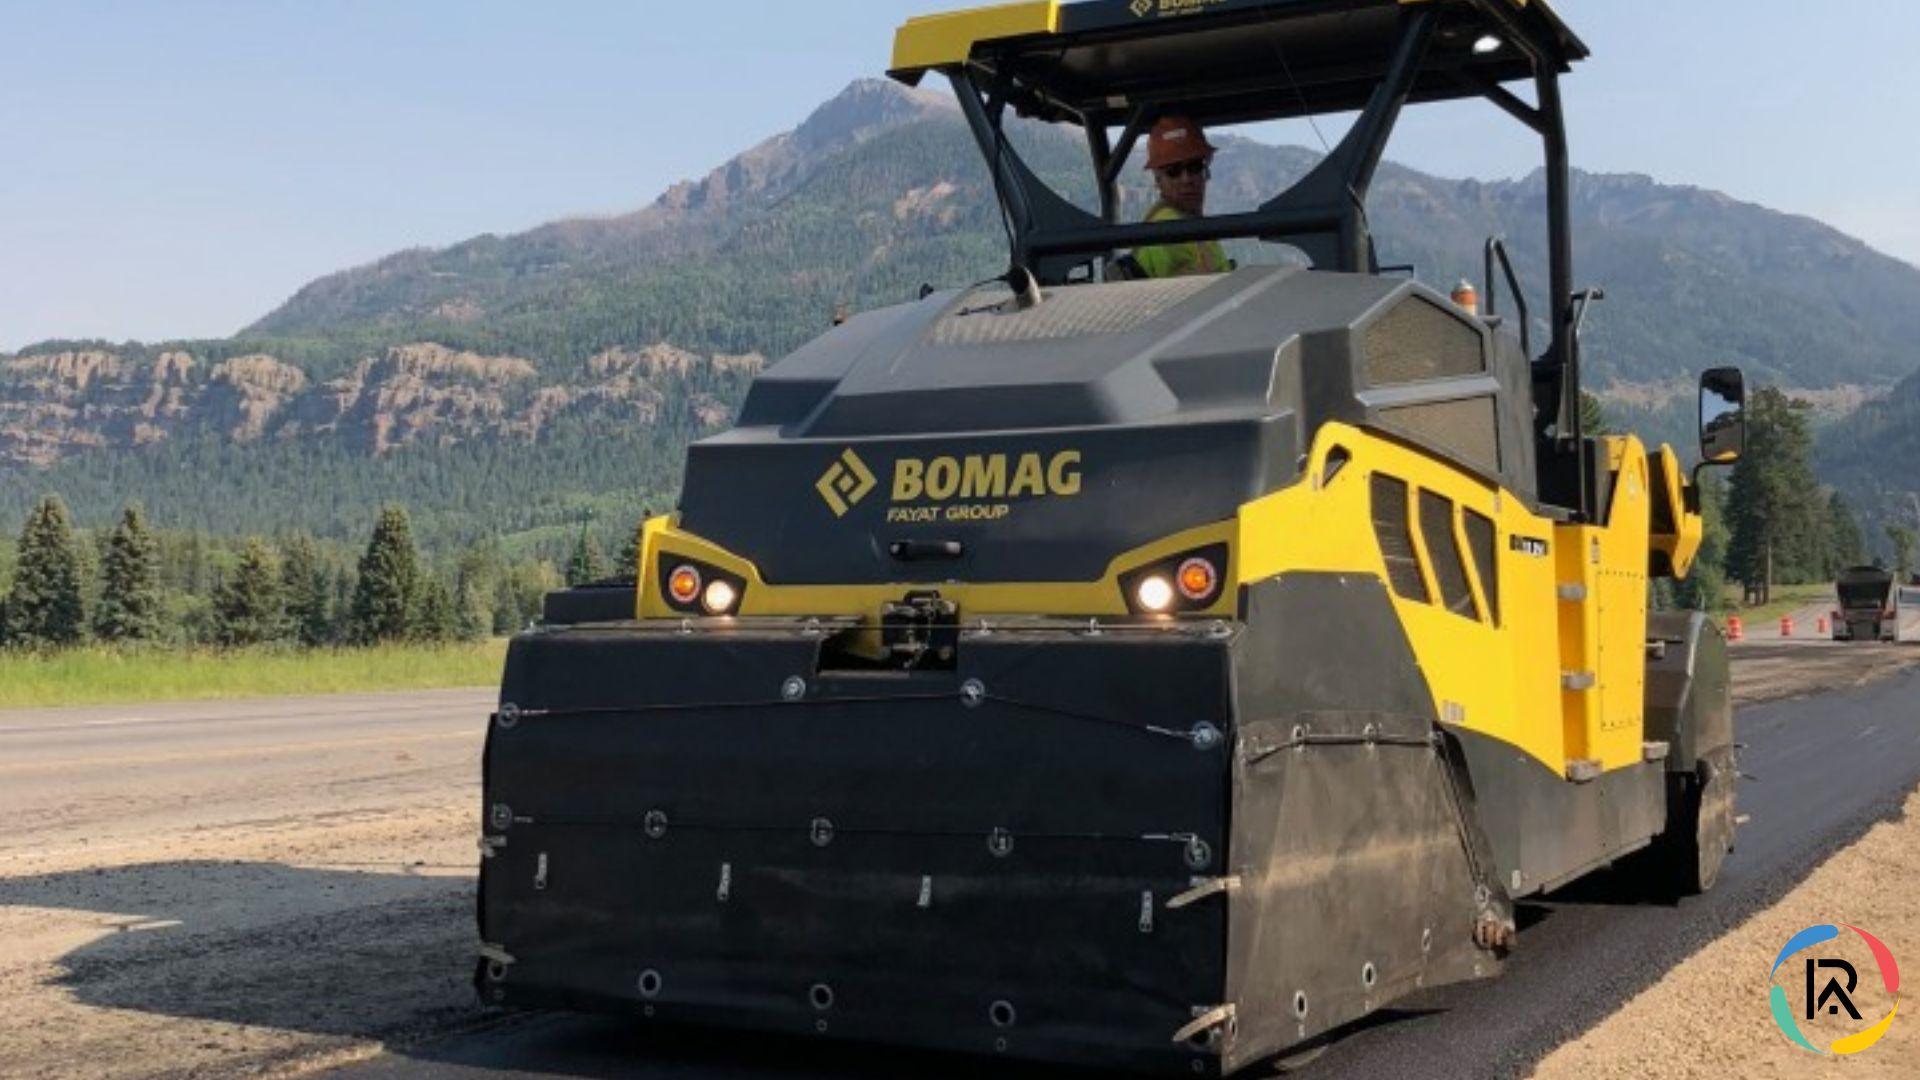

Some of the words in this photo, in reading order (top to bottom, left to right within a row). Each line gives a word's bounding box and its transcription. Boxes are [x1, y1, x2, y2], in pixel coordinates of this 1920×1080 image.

[892, 450, 1082, 501] BOMAG
[887, 506, 941, 522] FAYAT
[946, 504, 1009, 520] GROUP
